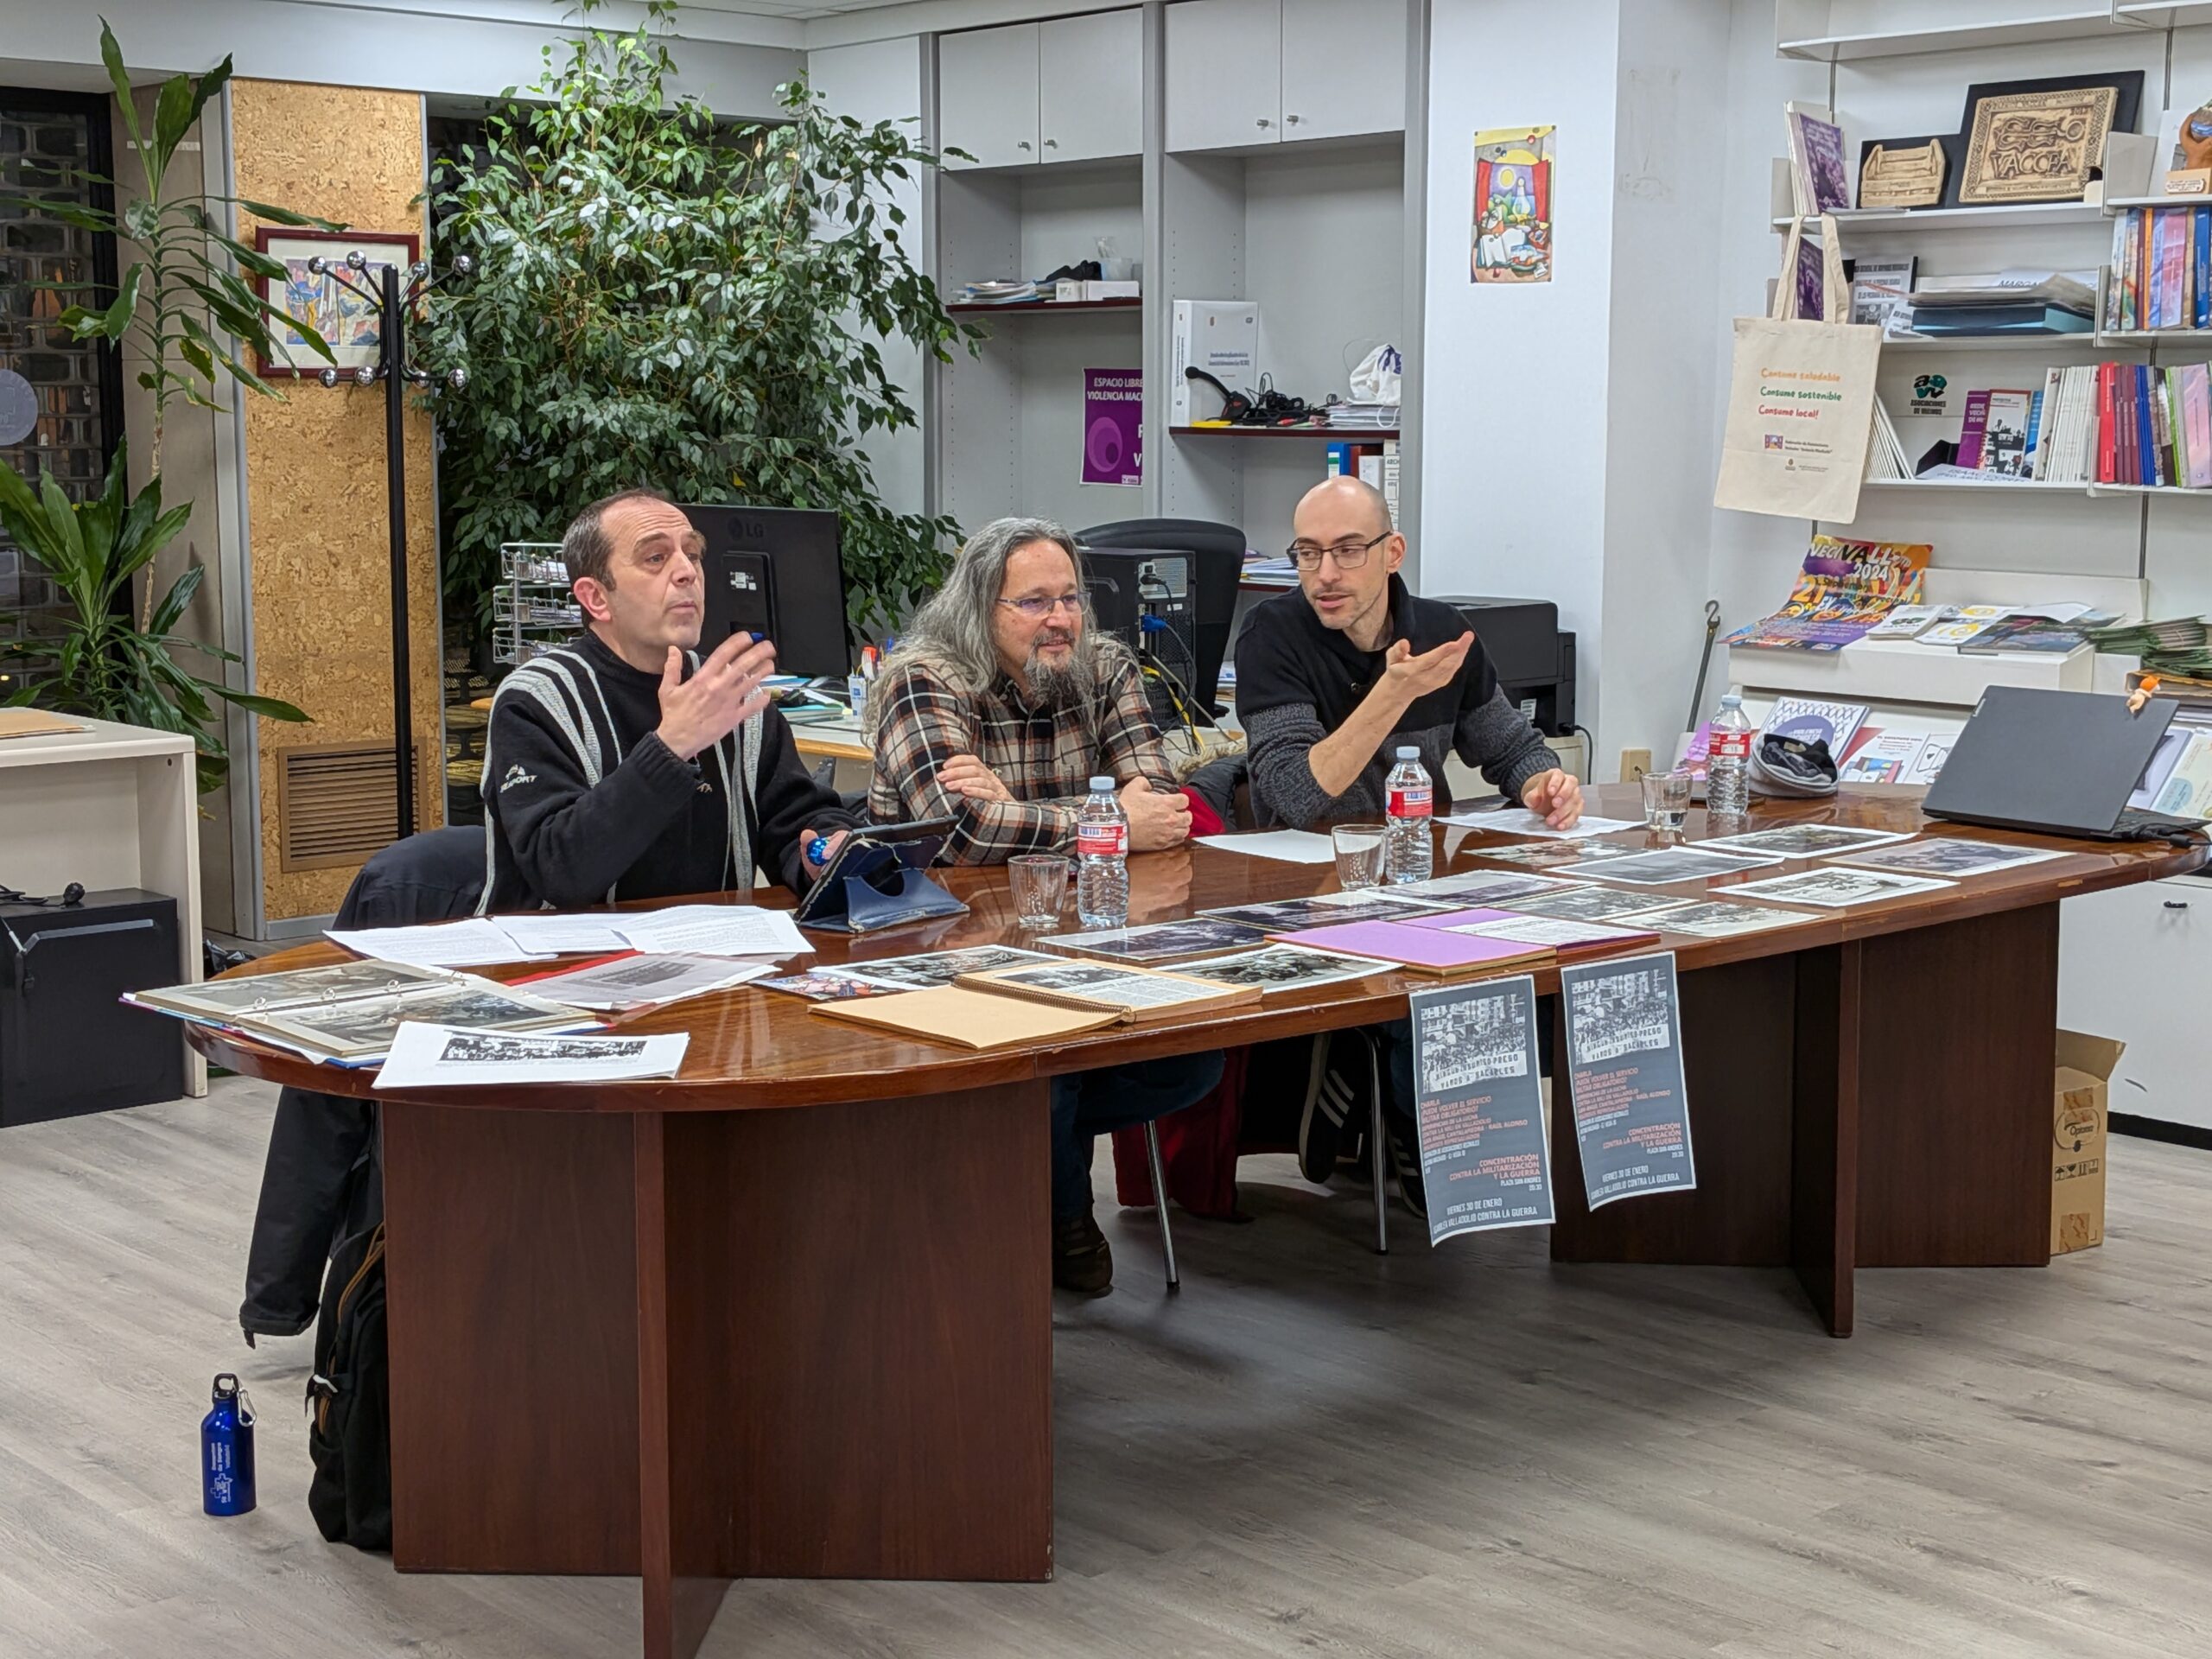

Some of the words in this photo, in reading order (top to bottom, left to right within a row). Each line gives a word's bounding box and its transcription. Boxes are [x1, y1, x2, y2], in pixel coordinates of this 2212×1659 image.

[1761, 367, 1797, 378] Consume
[1094, 378, 1124, 388] ESPACIO
[1087, 391, 1124, 401] VIOLENCIA
[1760, 386, 1796, 397] Consume
[1798, 391, 1842, 401] sostenible
[1758, 404, 1794, 416] Consume
[1796, 408, 1819, 419] local!
[746, 523, 764, 537] LG
[1853, 563, 1889, 581] 2024
[1479, 1154, 1539, 1167] CONCENTRACIÓN
[1510, 1168, 1541, 1179] GUERRA
[1483, 1198, 1503, 1209] ENERO
[1477, 1210, 1502, 1222] CONTRA
[1502, 1209, 1511, 1218] LA
[1511, 1206, 1538, 1217] GUERRA
